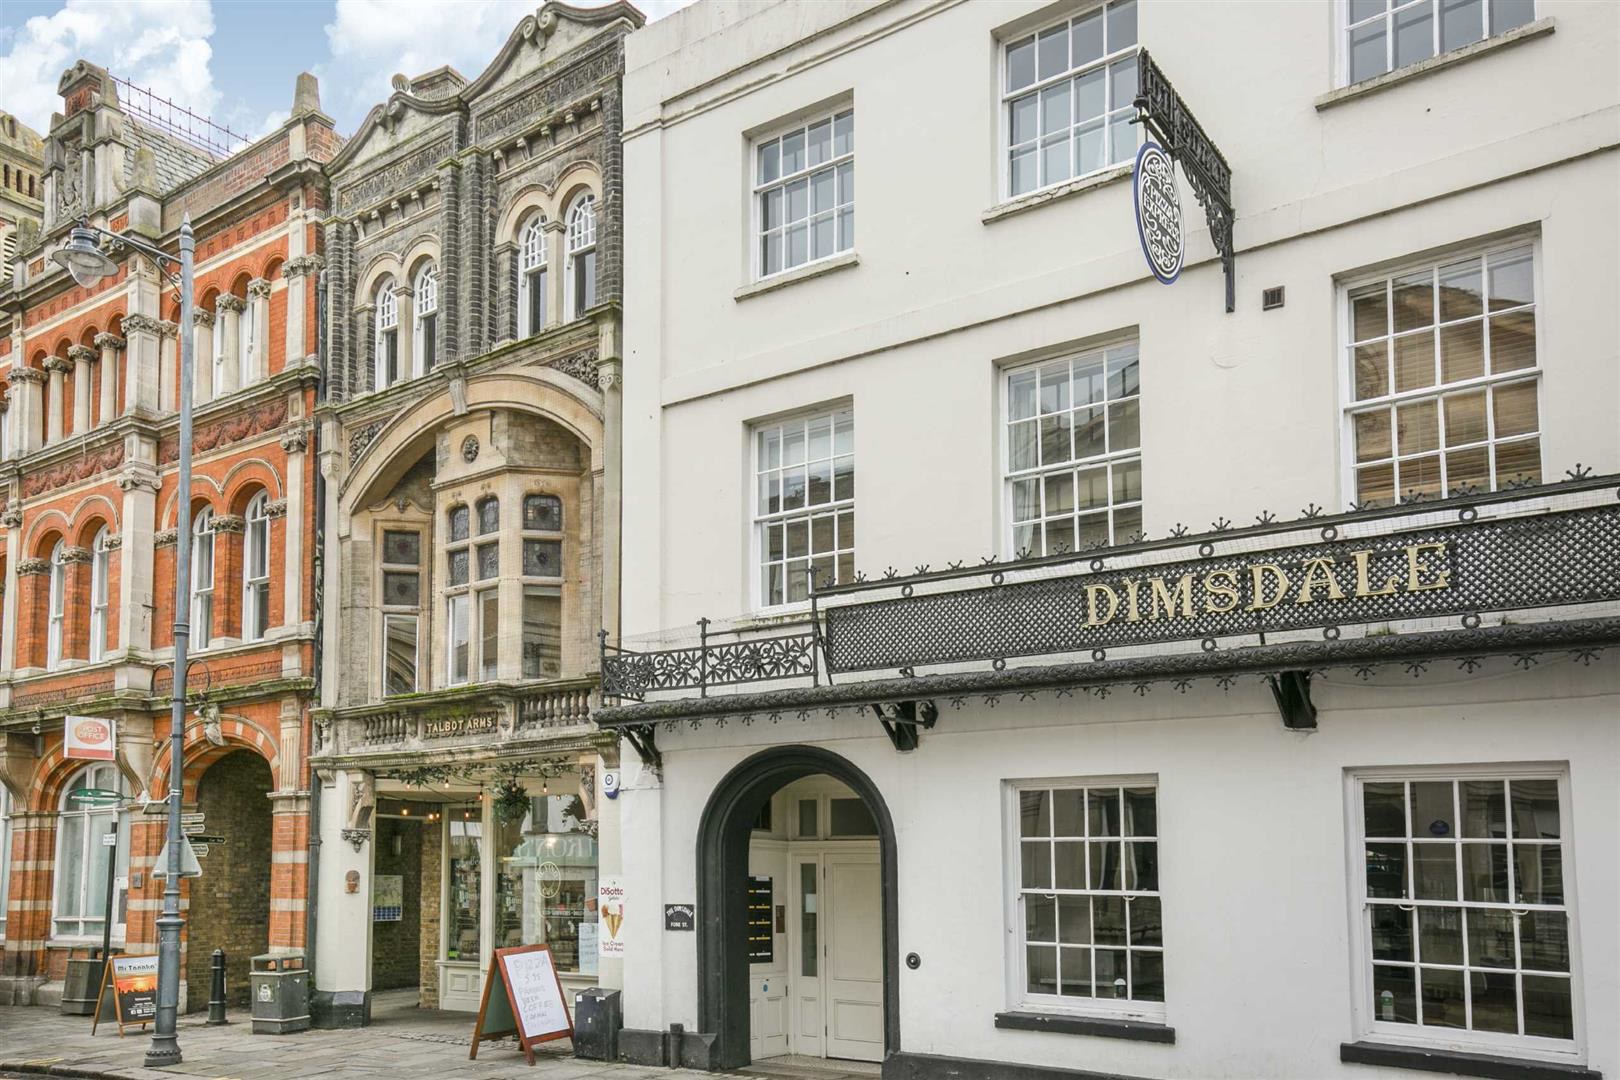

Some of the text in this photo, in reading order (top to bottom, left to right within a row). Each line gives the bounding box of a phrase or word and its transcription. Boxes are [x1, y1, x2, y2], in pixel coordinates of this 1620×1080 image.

[1150, 184, 1175, 222] PIZZA
[1143, 192, 1180, 243] EXPRESS
[1082, 541, 1451, 629] DIMSDALE
[78, 731, 105, 740] OFFICE
[80, 725, 103, 733] POST
[426, 717, 492, 734] TALBOT ARMS
